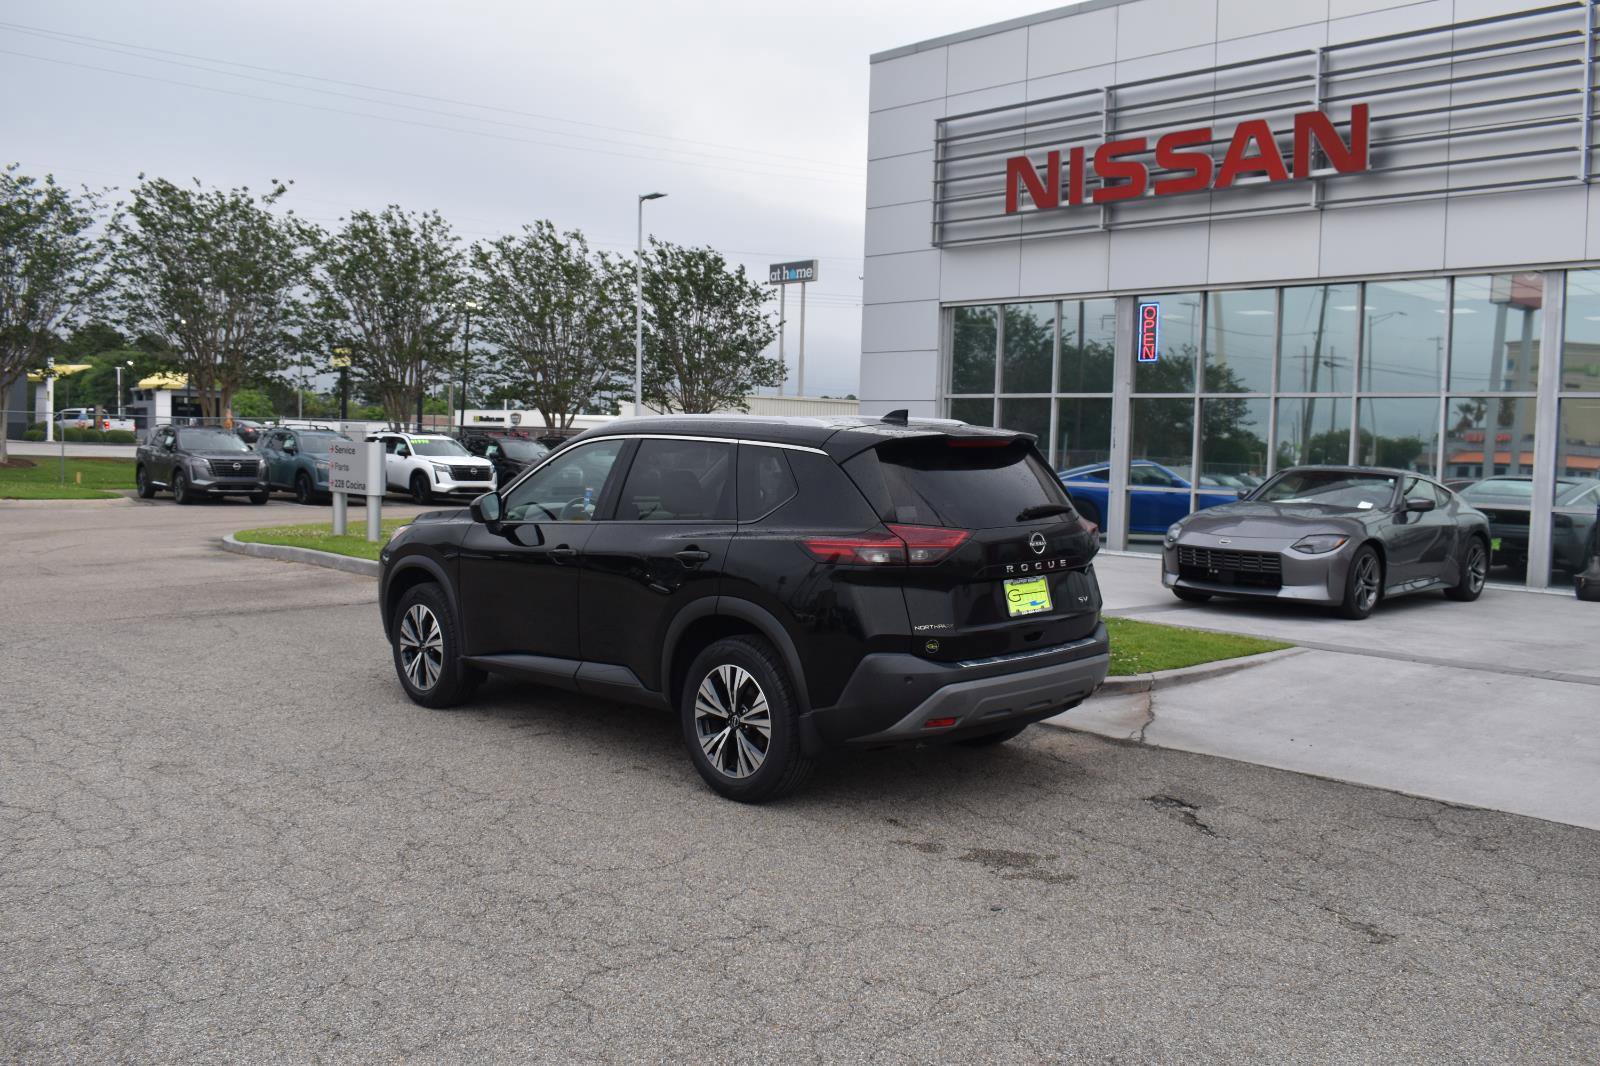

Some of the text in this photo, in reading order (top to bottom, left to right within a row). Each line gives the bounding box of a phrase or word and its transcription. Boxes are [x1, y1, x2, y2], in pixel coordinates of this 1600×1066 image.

[1005, 103, 1370, 215] NISSAN
[1143, 306, 1157, 360] OPEN
[334, 445, 356, 455] Service
[334, 462, 350, 472] Parts
[1006, 559, 1067, 573] ROGUE
